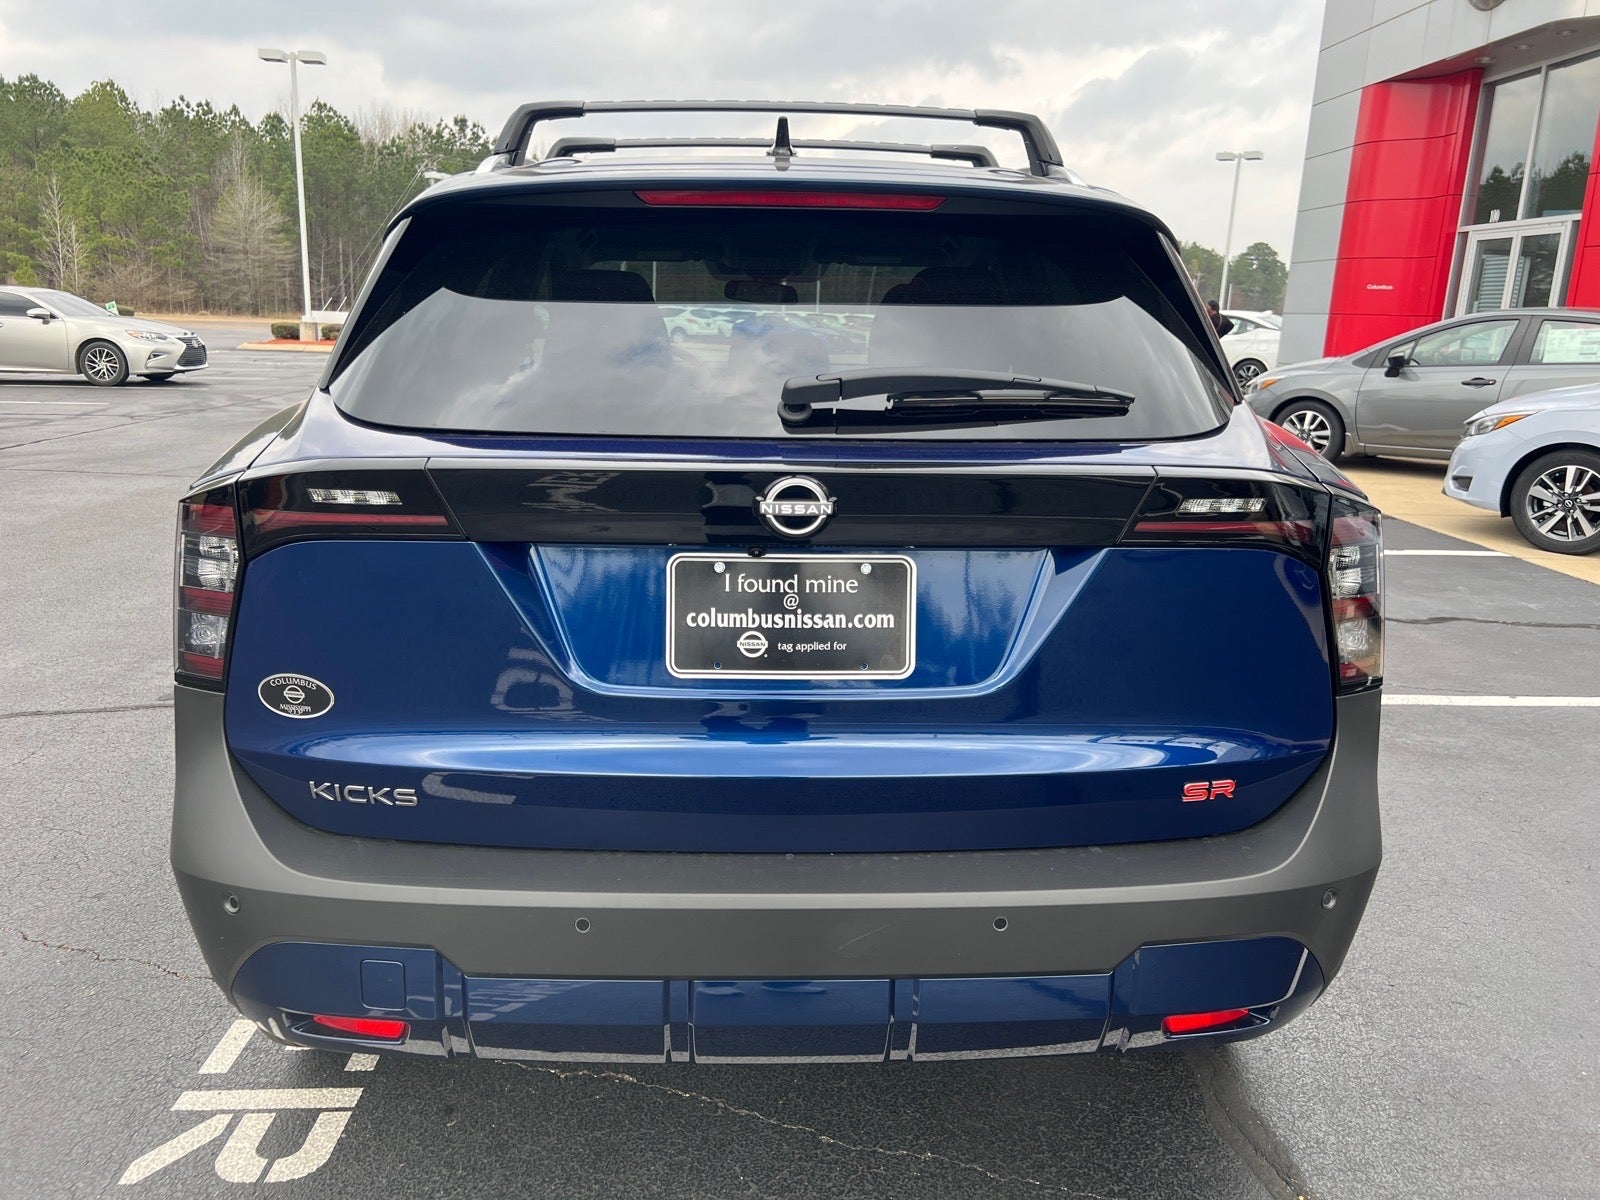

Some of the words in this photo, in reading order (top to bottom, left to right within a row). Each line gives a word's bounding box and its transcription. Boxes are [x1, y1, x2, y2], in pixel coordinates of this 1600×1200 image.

[761, 504, 832, 515] NISSAN
[724, 573, 731, 592] I
[737, 573, 798, 593] found
[805, 575, 859, 593] mine
[783, 593, 799, 609] @
[686, 608, 895, 629] columbusnissan.com
[777, 641, 793, 652] tag
[795, 641, 830, 652] applied
[833, 641, 847, 650] for
[270, 677, 317, 690] COLUMBUS
[309, 781, 418, 807] KICKS
[1182, 779, 1236, 802] SR
